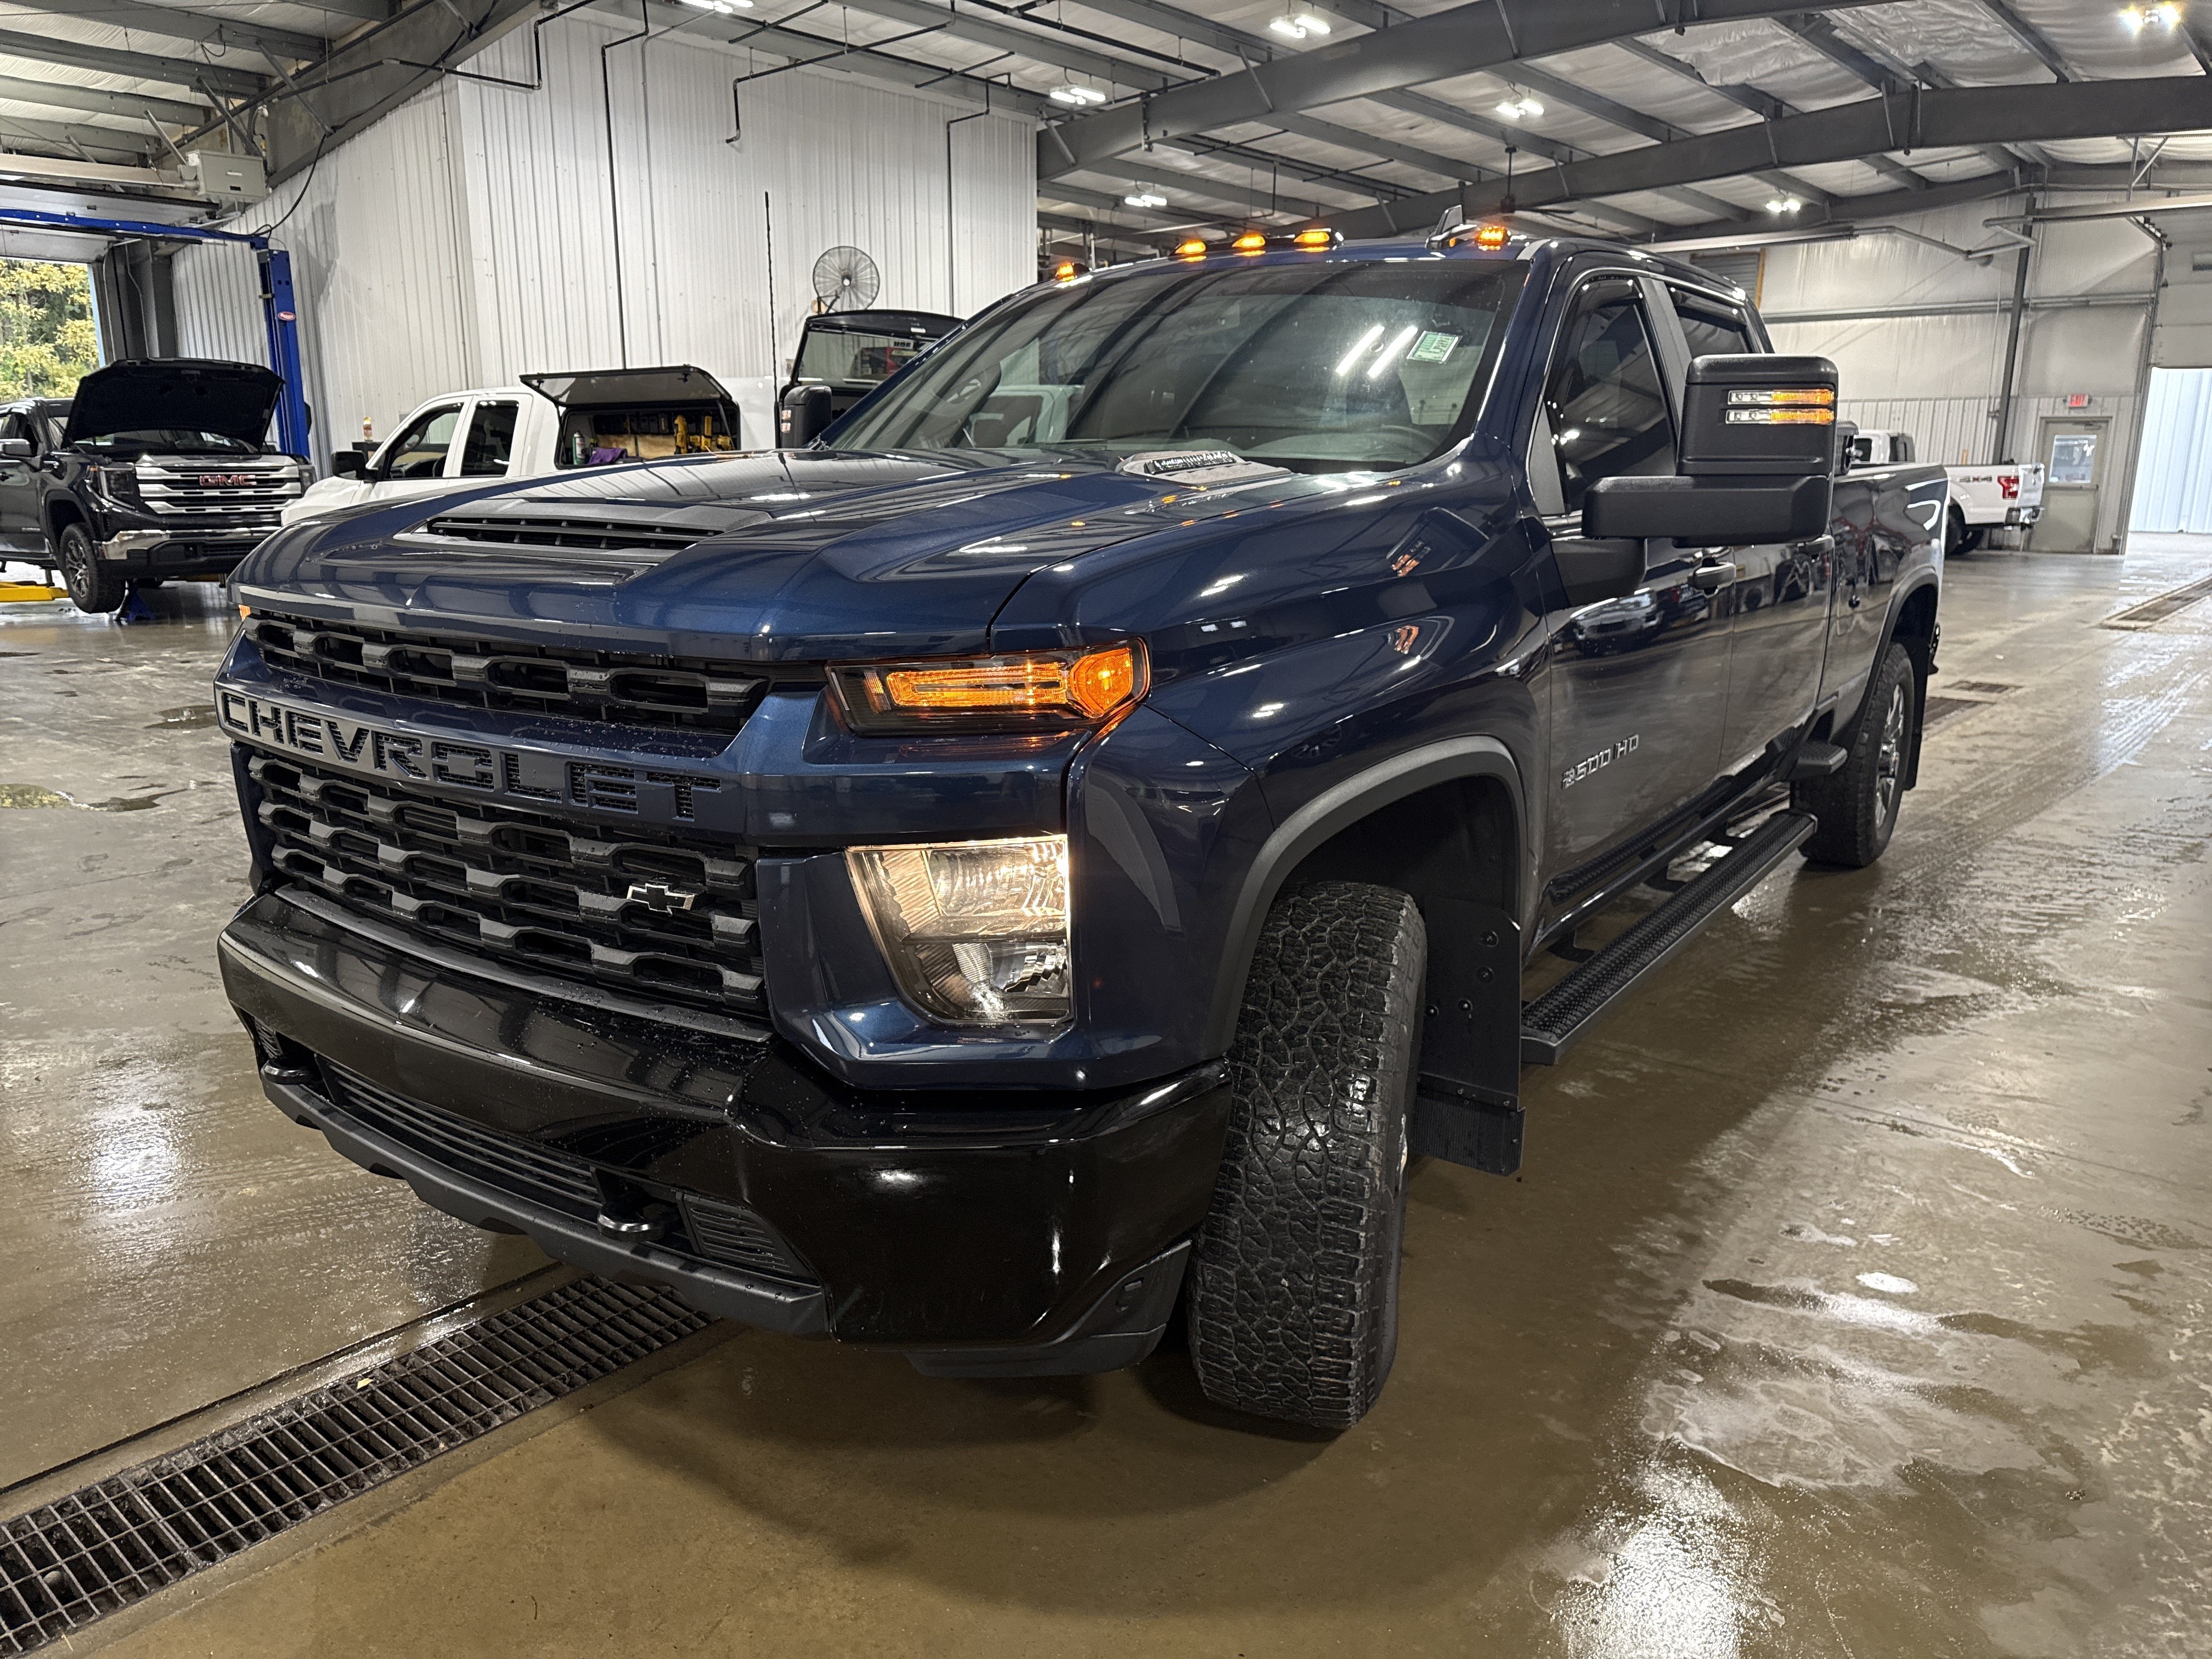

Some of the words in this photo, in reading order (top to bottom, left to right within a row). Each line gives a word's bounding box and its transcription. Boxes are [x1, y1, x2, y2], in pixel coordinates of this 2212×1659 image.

[199, 475, 257, 486] GMC
[221, 691, 721, 822] CHEVROLET
[1561, 748, 1611, 789] 2500
[1613, 733, 1639, 760] HD
